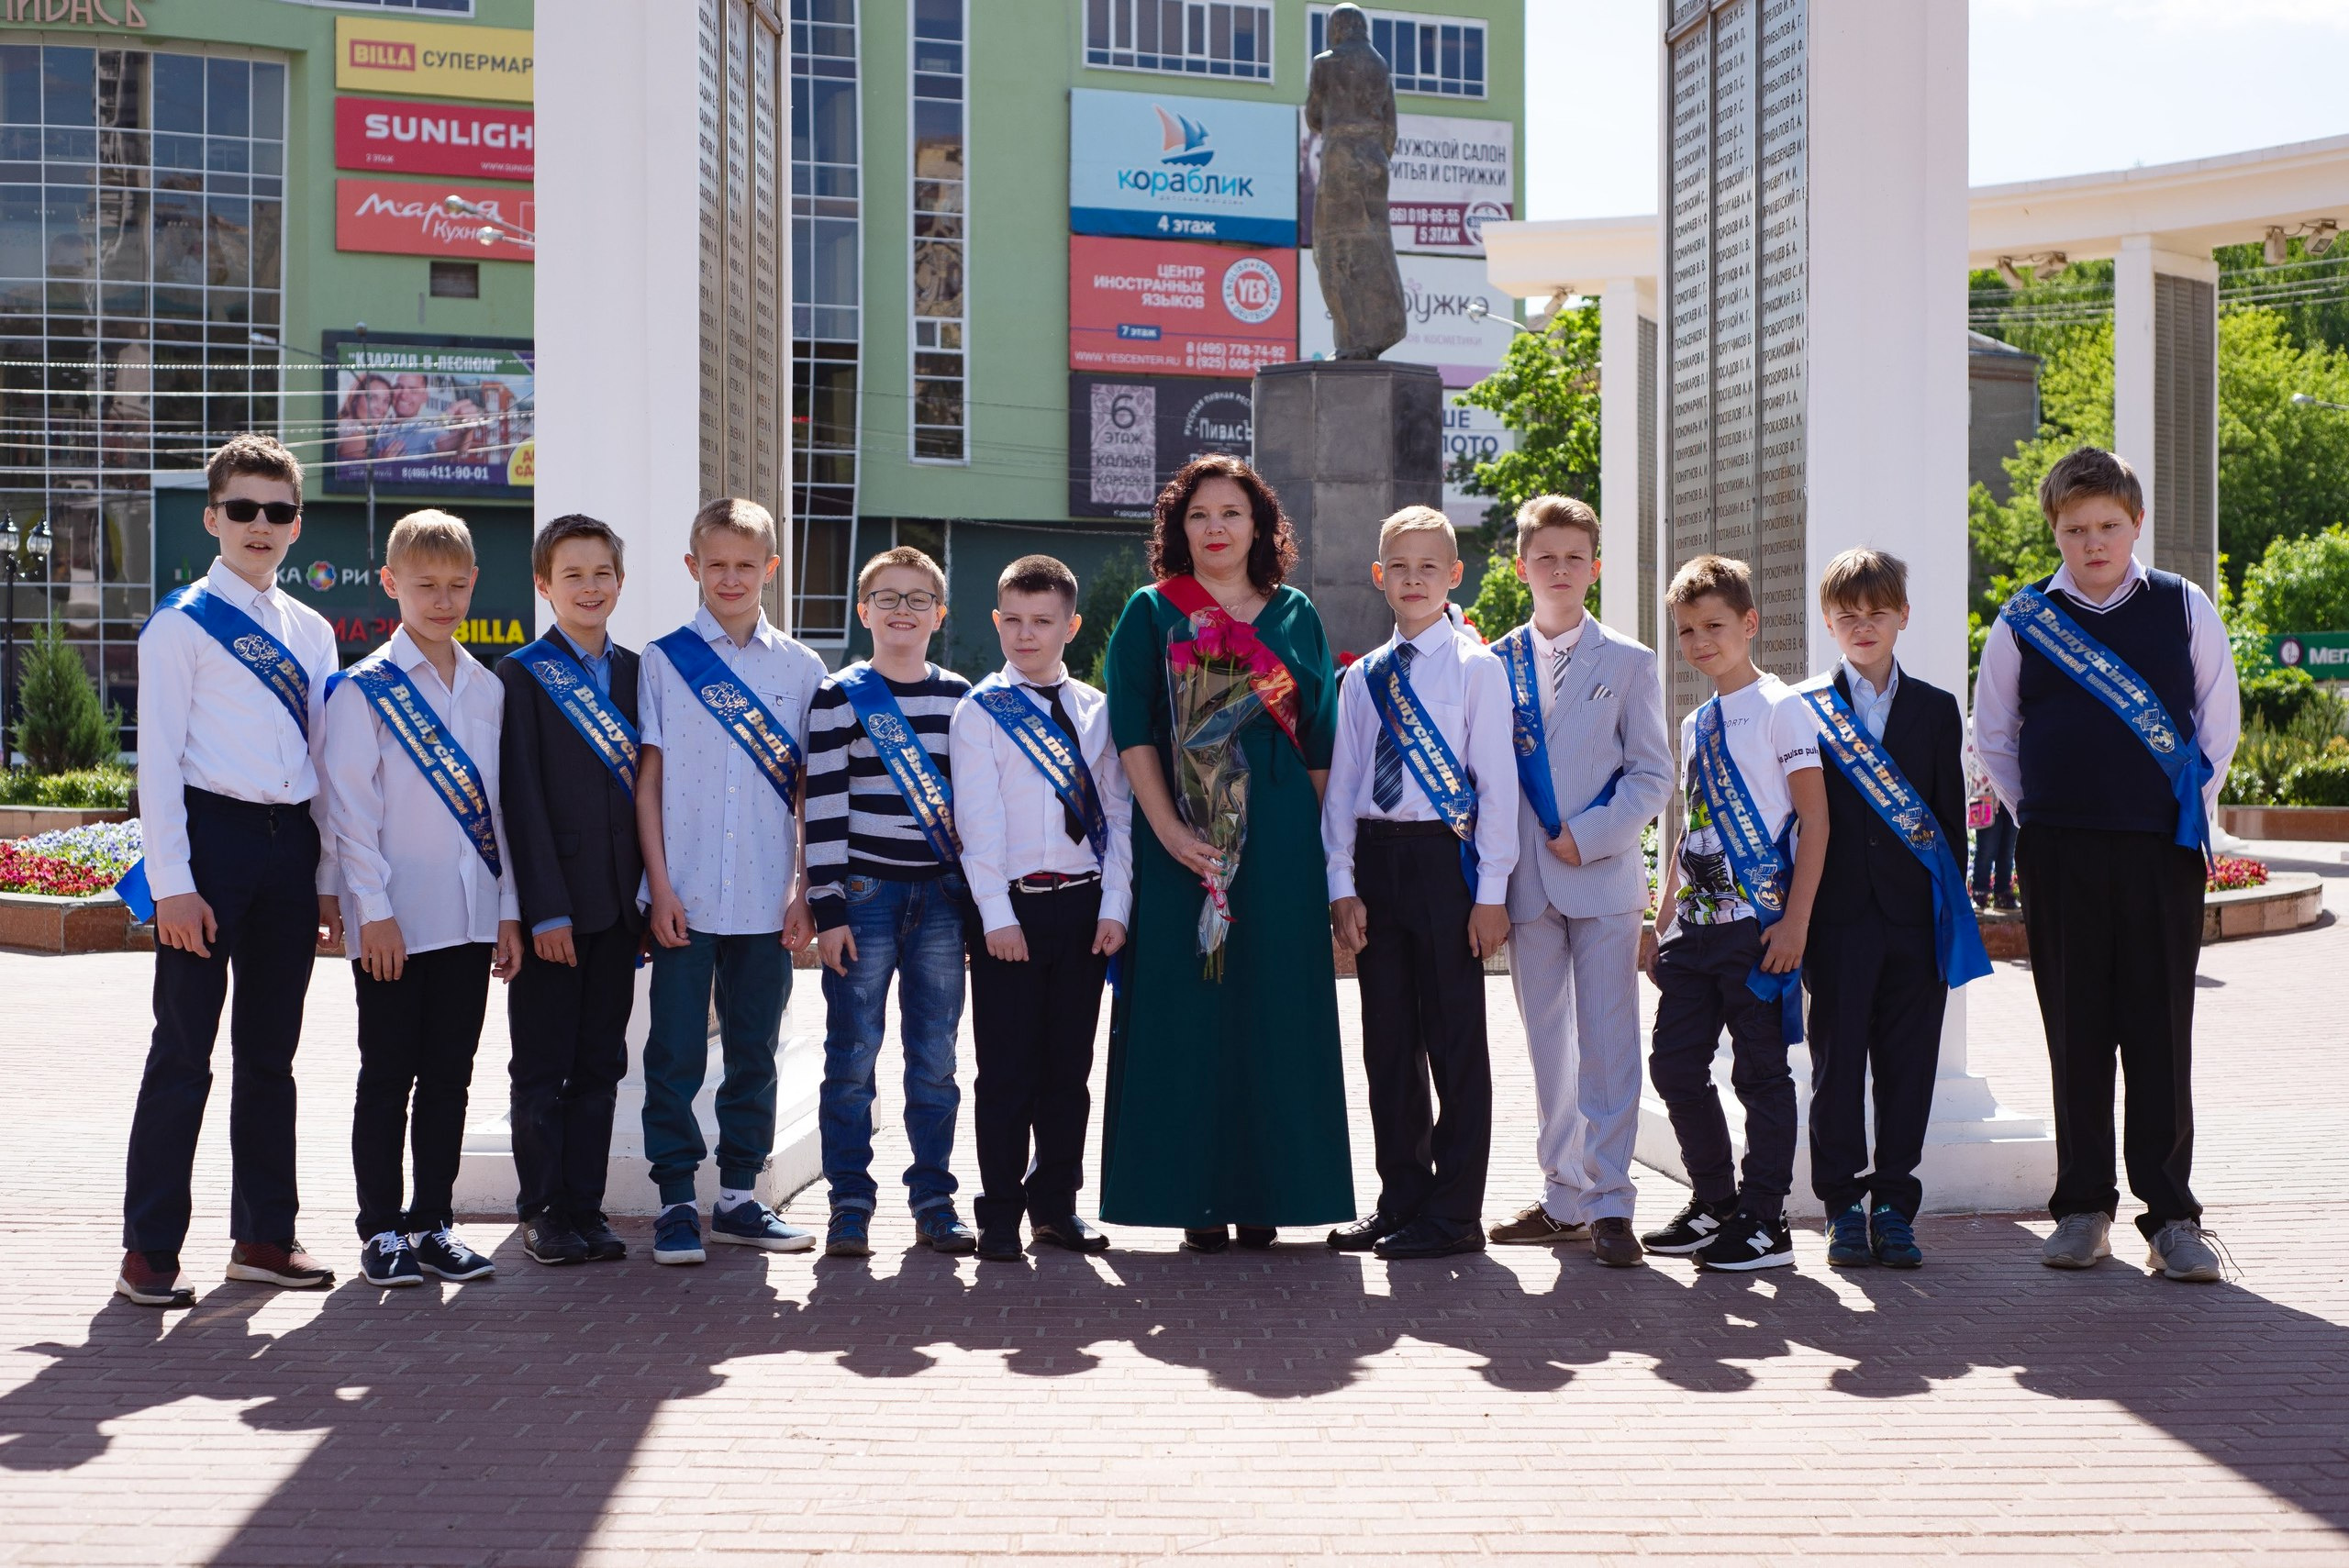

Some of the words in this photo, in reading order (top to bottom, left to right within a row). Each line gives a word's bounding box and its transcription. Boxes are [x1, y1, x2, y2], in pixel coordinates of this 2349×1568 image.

[353, 44, 412, 67] BILLA
[422, 50, 533, 73] СУПЕРМАР
[365, 115, 532, 150] SUNLIGH
[1462, 142, 1507, 163] САЛОН
[1118, 168, 1253, 197] кораблик
[1431, 164, 1441, 182] И
[1442, 165, 1507, 186] СТРИЖКИ
[433, 220, 483, 244] Кухн
[1158, 214, 1170, 233] 4
[1173, 218, 1217, 235] этаж
[1429, 227, 1460, 242] ЭТАЖ
[1157, 264, 1206, 279] ЦЕНТР
[1094, 274, 1205, 294] ИНОСТРАННЫХ
[1238, 278, 1268, 304] YES
[1141, 293, 1205, 309] ЯЗЫКОВ
[1121, 326, 1130, 337] 7
[1112, 393, 1136, 429] 6
[1104, 431, 1143, 445] ЭТАЖ
[1097, 453, 1152, 469] КАЛЬЯН
[453, 619, 526, 644] BILLA
[2033, 606, 2149, 707] Выпускник
